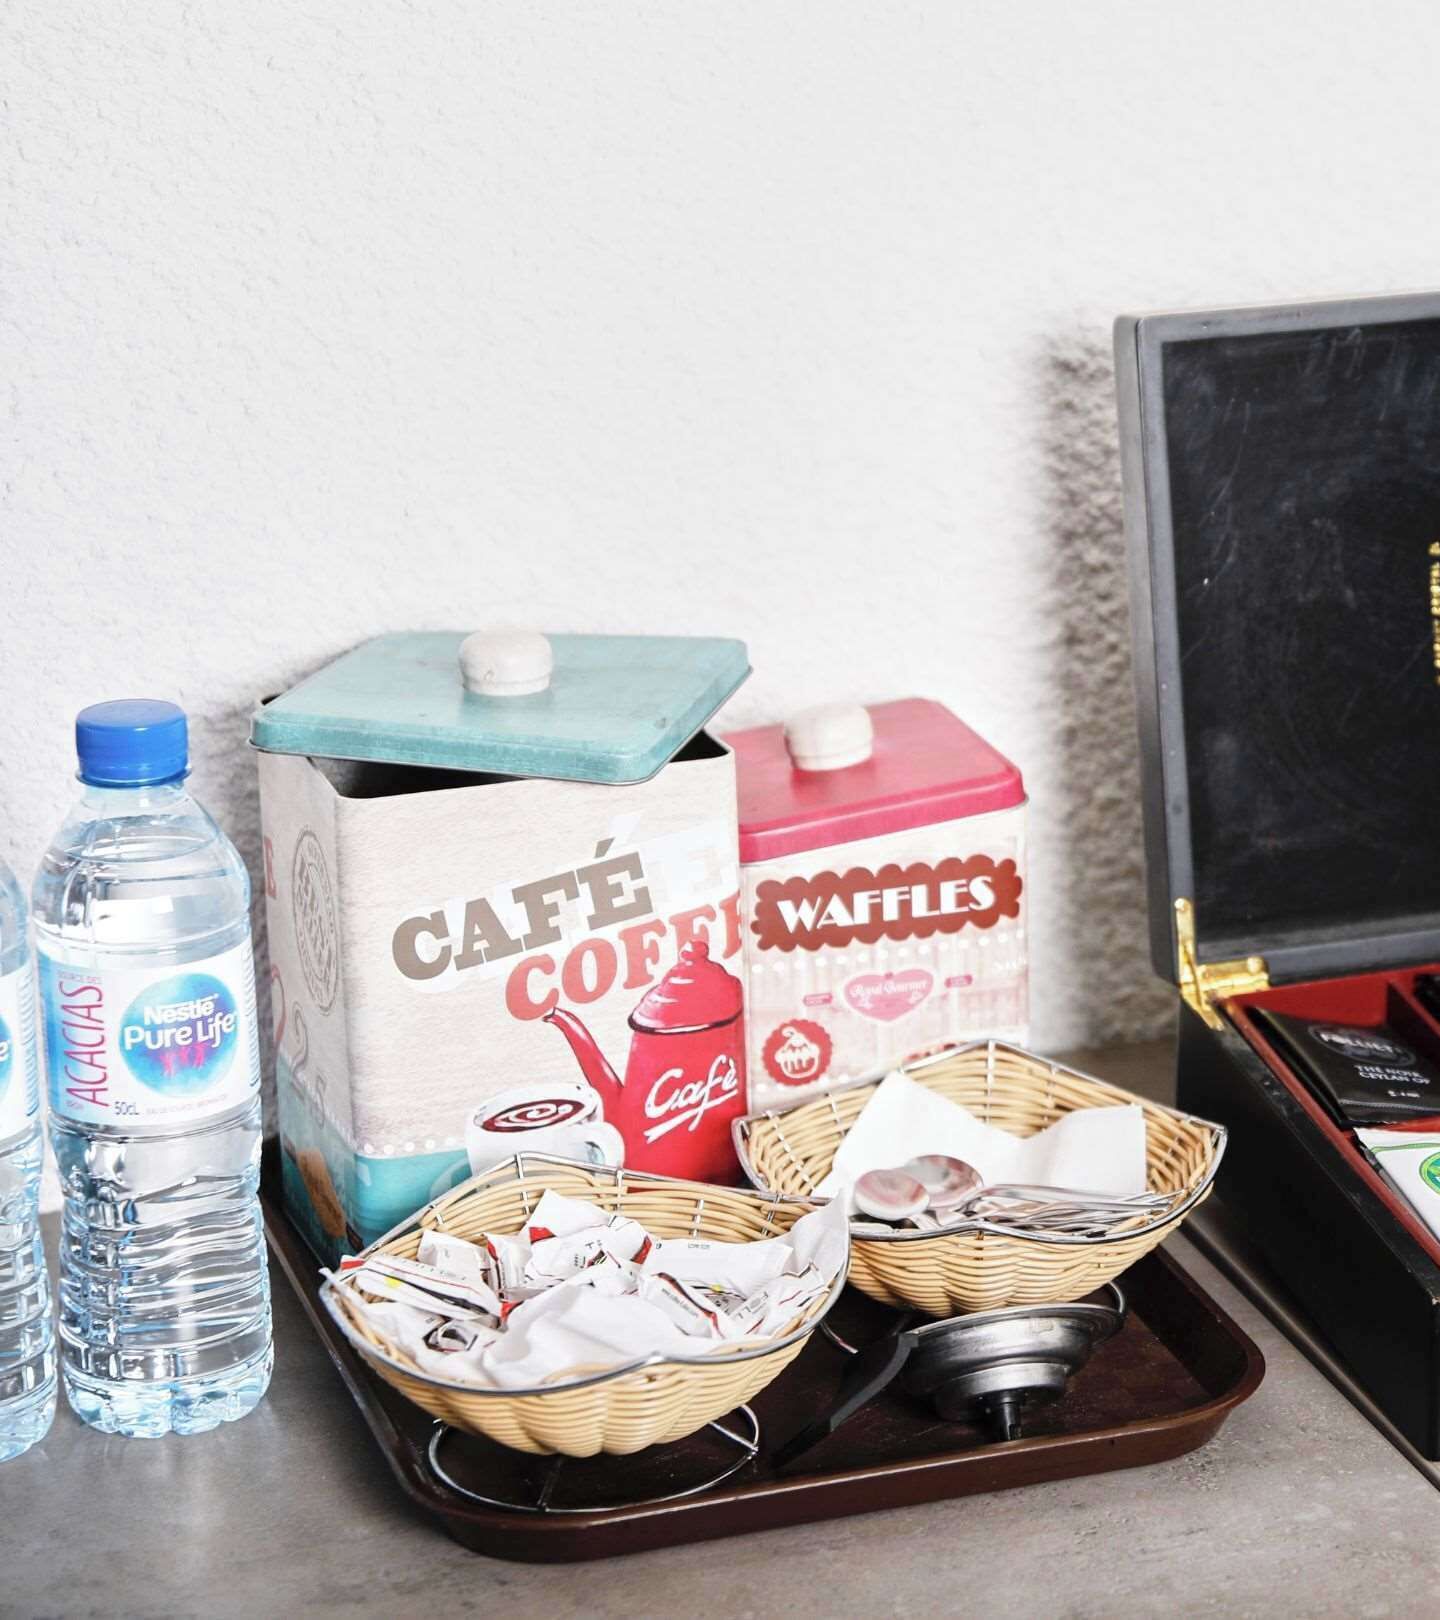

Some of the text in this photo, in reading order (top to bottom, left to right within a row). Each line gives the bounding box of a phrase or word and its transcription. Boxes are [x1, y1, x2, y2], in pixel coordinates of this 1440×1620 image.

[391, 836, 654, 981] CAFÉ
[776, 875, 996, 935] WAFFLES
[123, 1012, 236, 1051] Pure Life
[143, 996, 215, 1026] Nestlé
[59, 979, 110, 1107] ACACIAS
